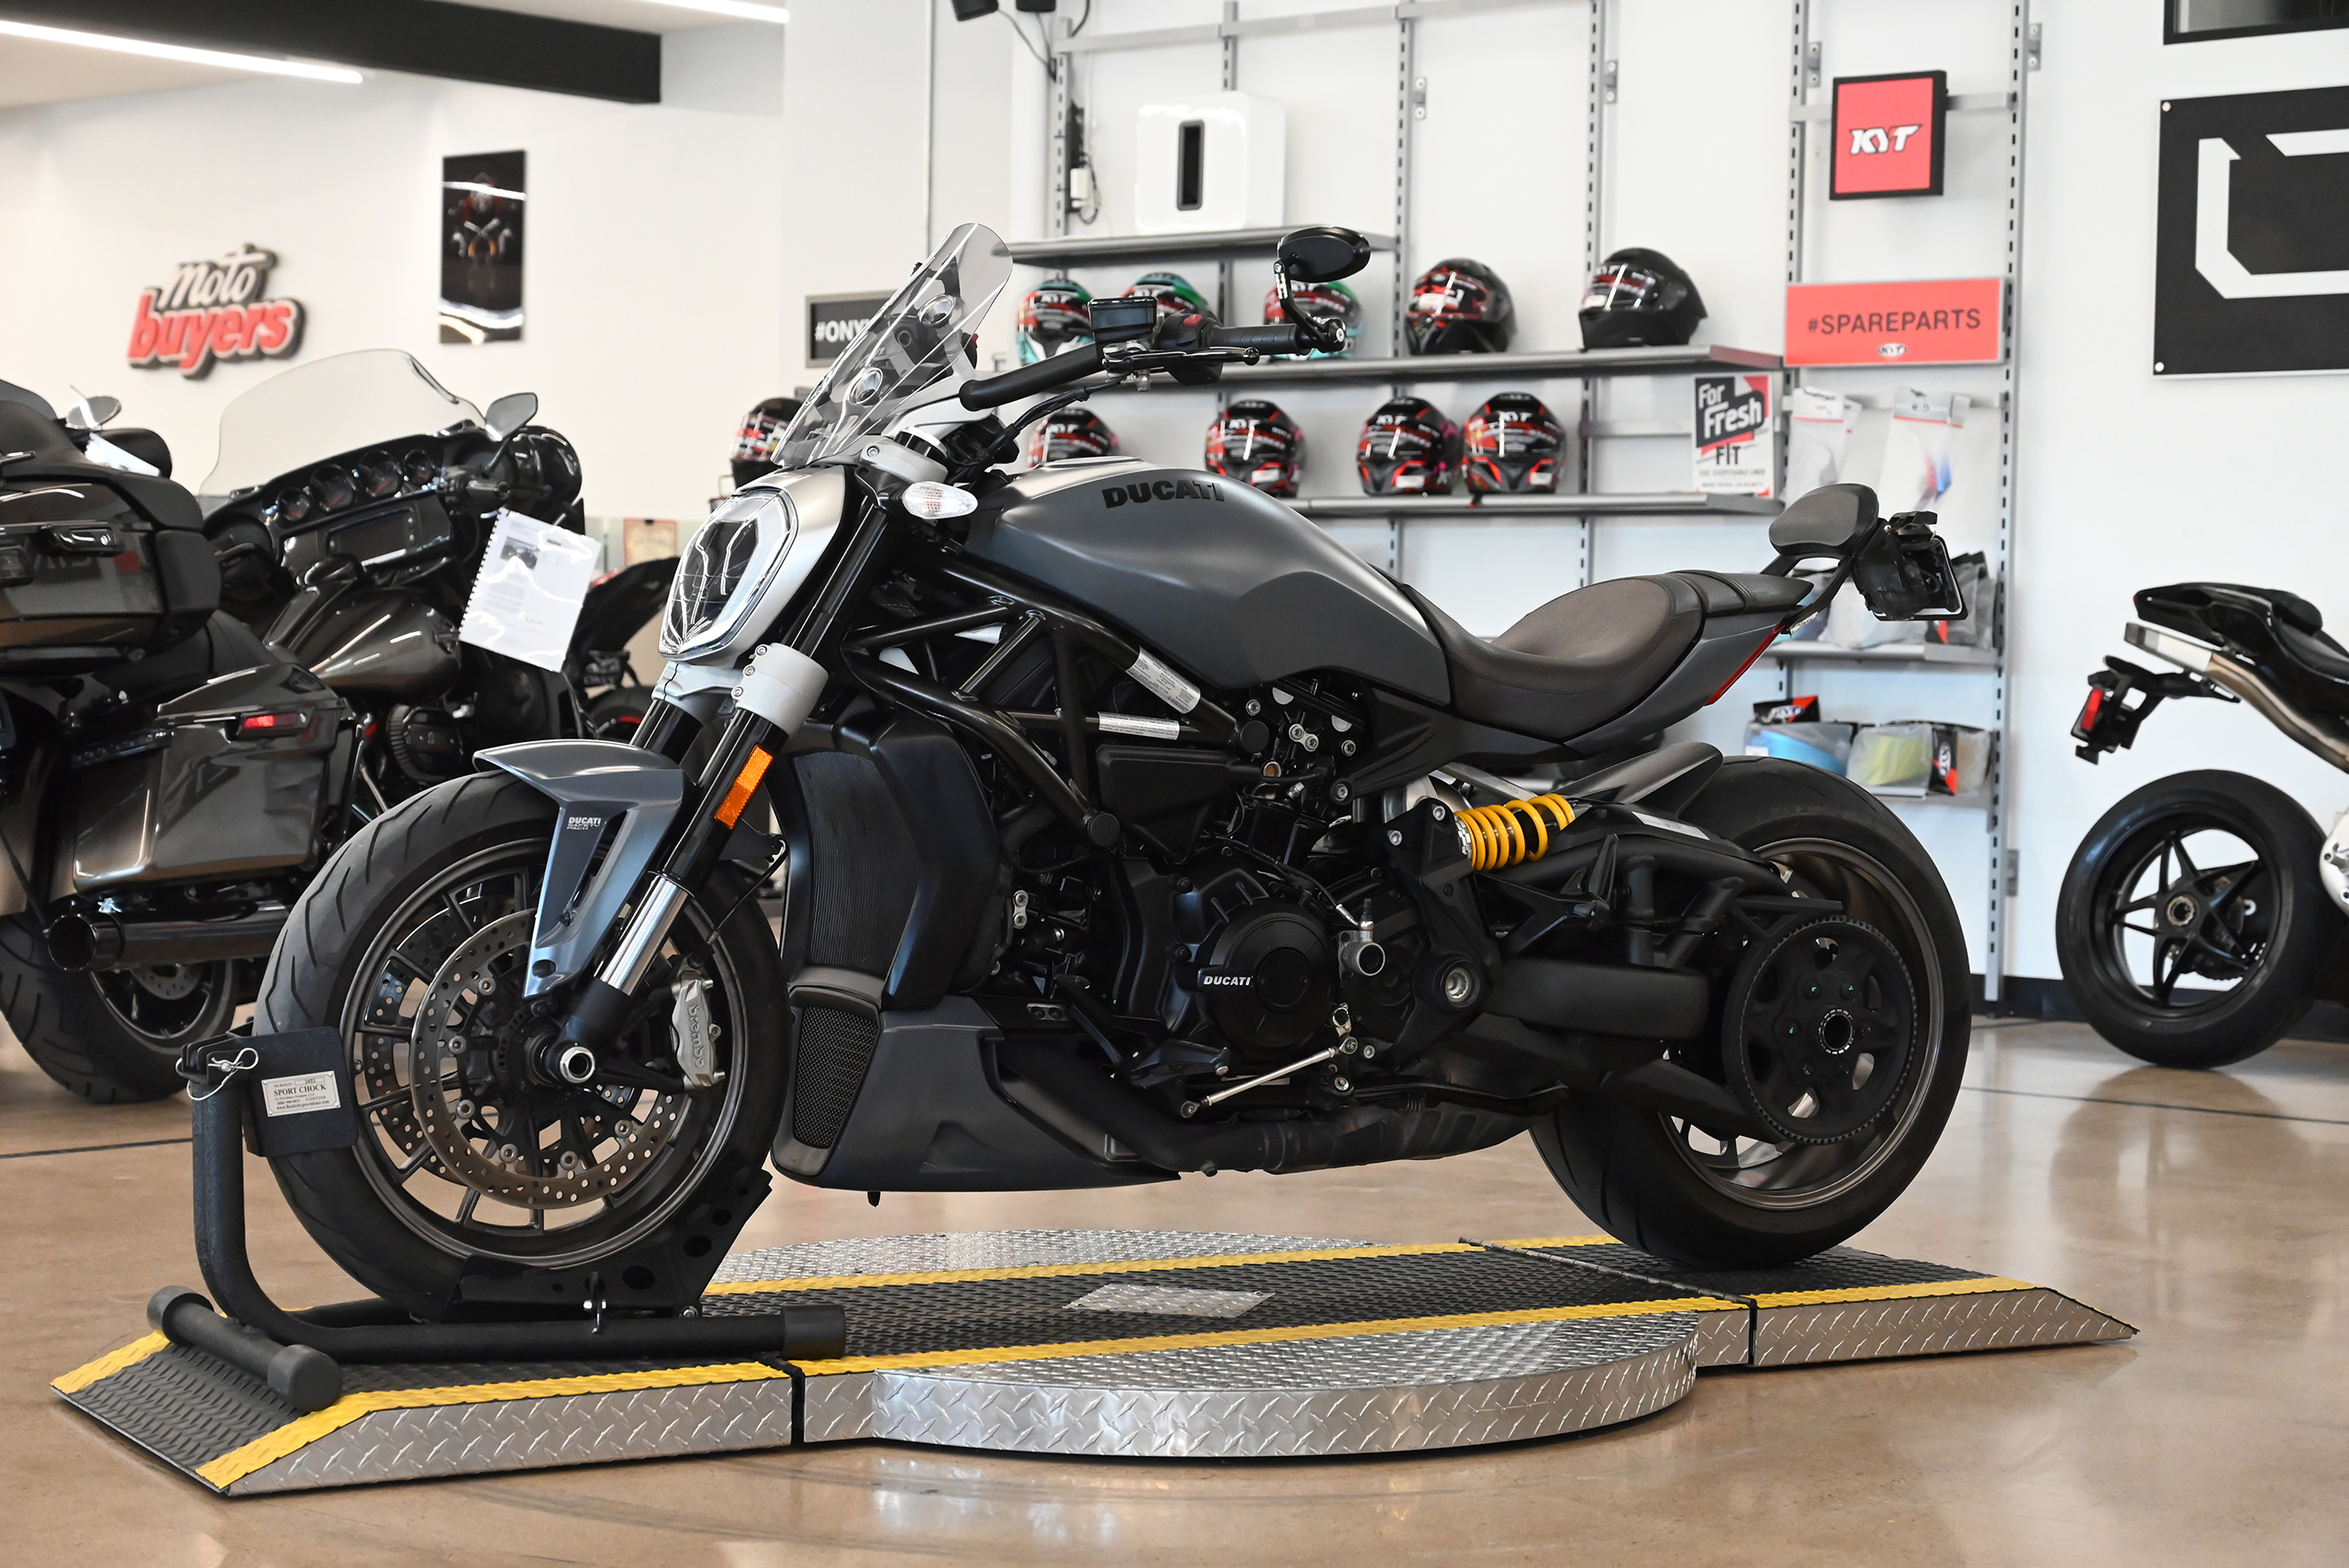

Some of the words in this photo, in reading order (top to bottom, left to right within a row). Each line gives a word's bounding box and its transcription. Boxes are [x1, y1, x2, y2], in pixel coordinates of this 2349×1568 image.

[1849, 123, 1923, 155] KYT
[157, 247, 266, 309] Moto
[127, 292, 294, 372] buyers
[1808, 308, 1981, 335] #SPAREPARTS
[1698, 383, 1726, 409] For
[1704, 397, 1763, 439] Fresh
[1716, 442, 1742, 465] FIT
[1102, 480, 1225, 508] DUCATI
[1203, 975, 1252, 985] DUCATI
[687, 1005, 705, 1067] brembo
[273, 1086, 297, 1096] SPORT
[298, 1084, 327, 1094] CHOCK
